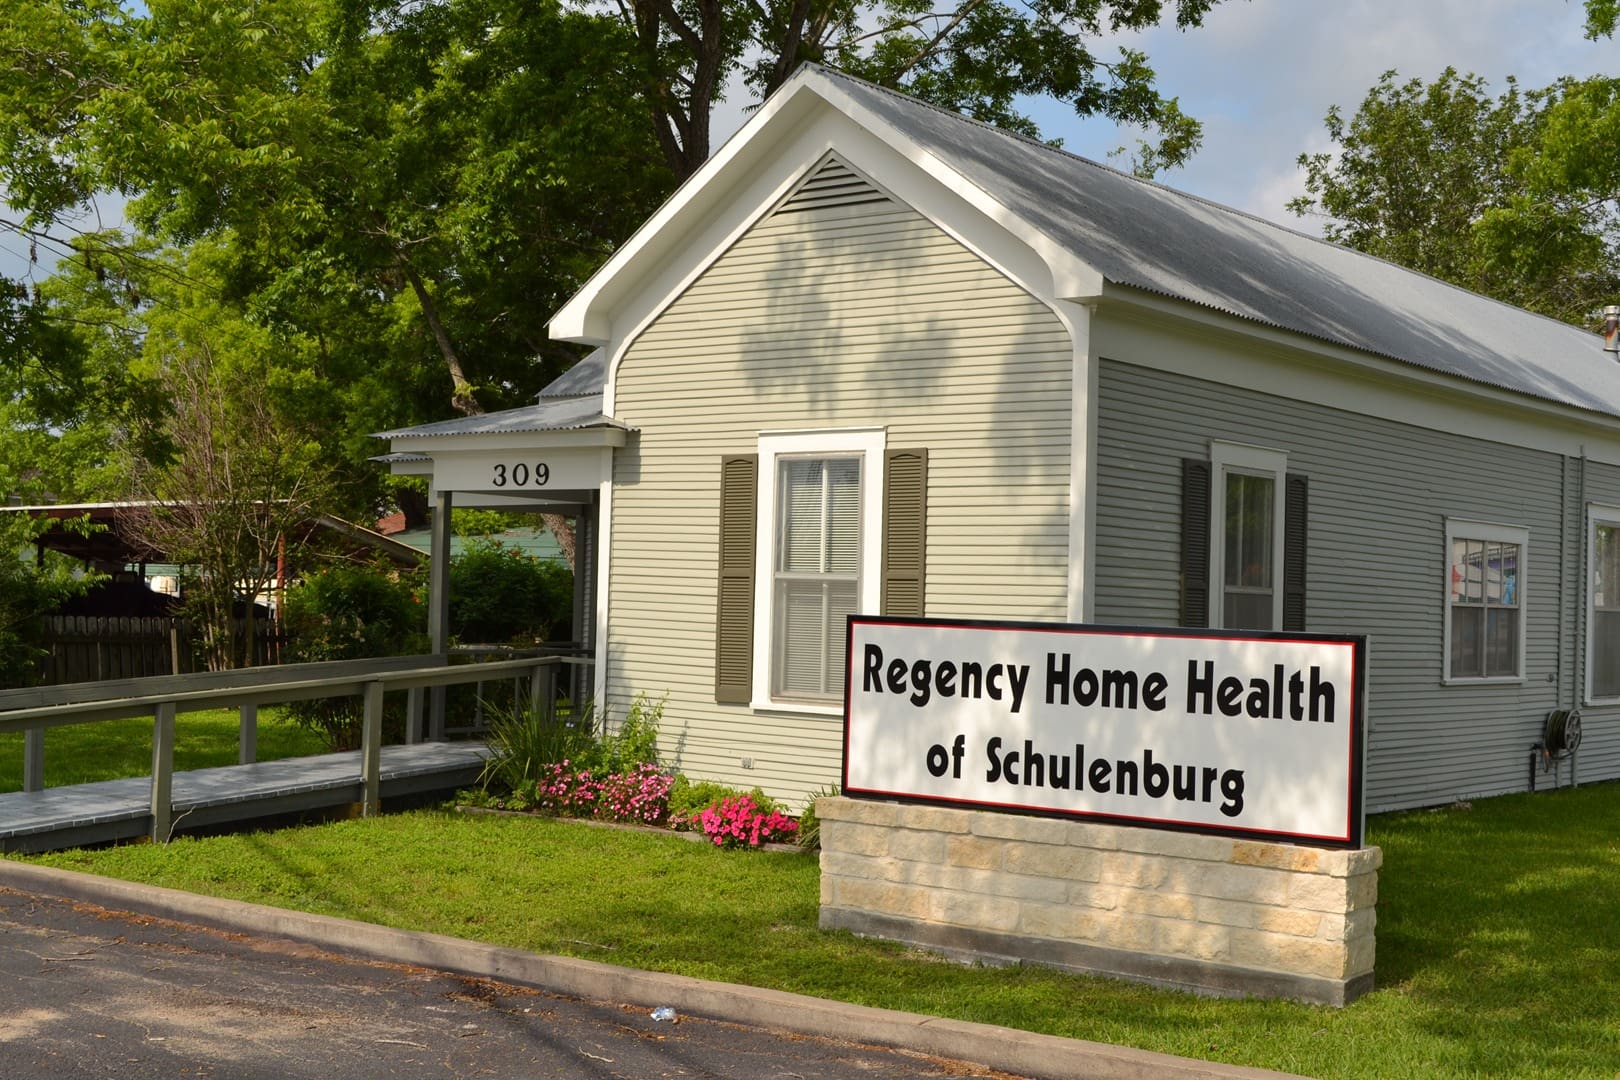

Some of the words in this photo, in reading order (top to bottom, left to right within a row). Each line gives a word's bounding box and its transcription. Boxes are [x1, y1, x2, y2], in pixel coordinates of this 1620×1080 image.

[492, 463, 551, 487] 309
[863, 643, 1031, 713] Regency
[1045, 652, 1169, 712] Home
[1186, 659, 1336, 723] Health
[926, 734, 965, 779] of
[986, 736, 1245, 818] Schulenburg
